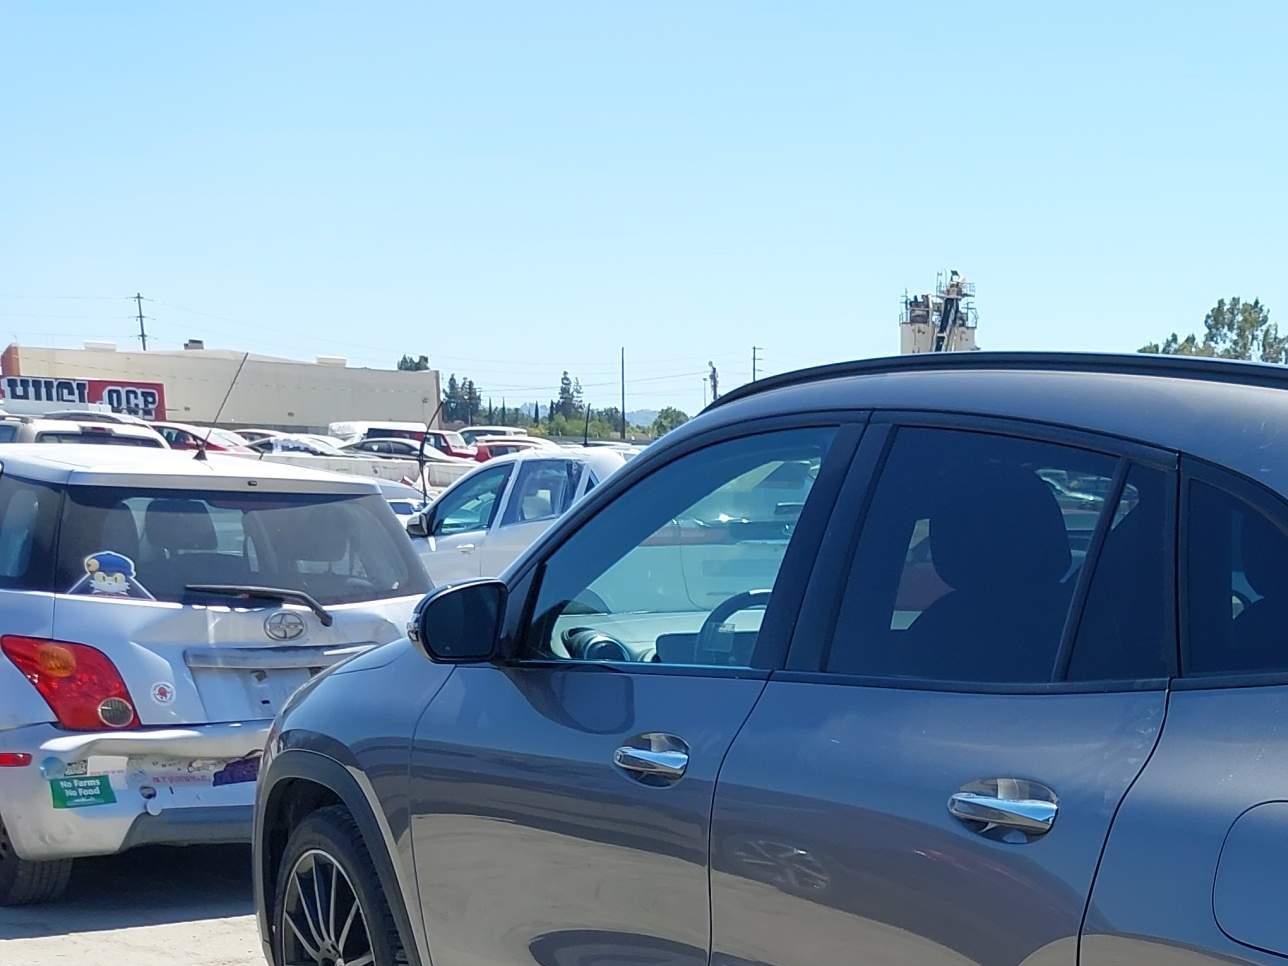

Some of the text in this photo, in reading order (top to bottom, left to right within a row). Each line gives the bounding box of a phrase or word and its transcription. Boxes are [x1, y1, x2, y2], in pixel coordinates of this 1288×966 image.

[60, 778, 101, 788] No Farms
[65, 786, 100, 797] No Food
